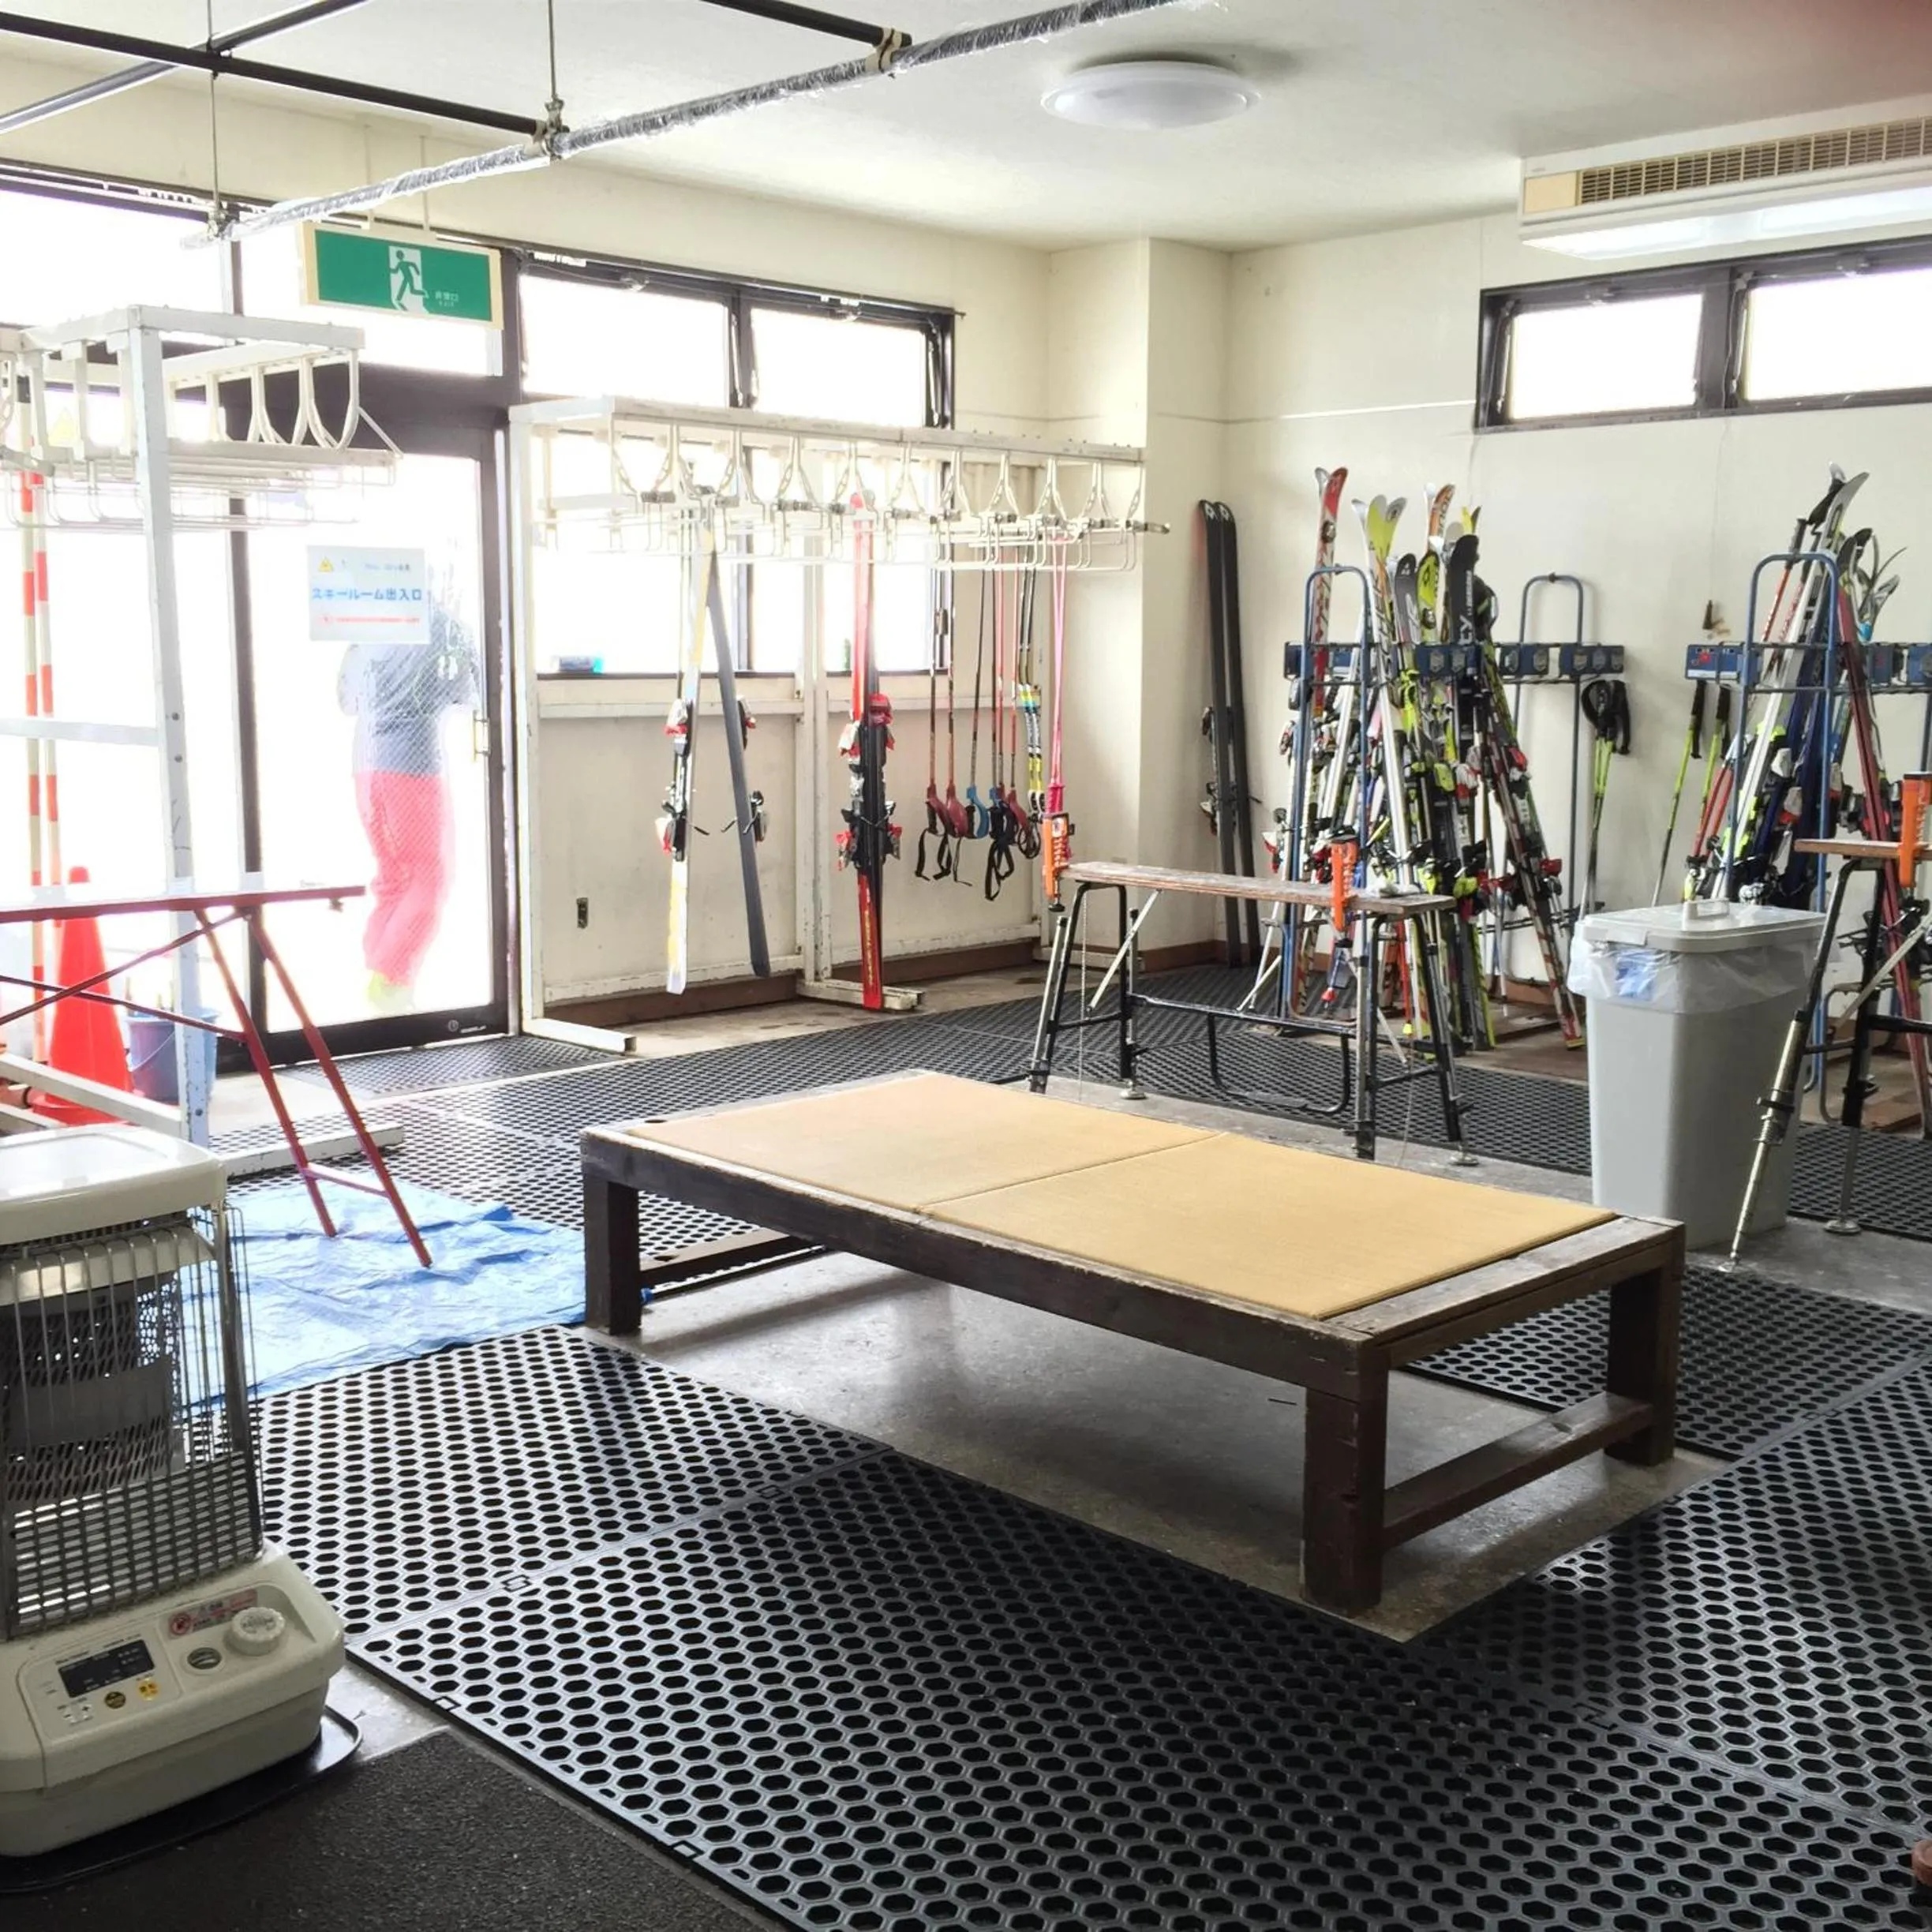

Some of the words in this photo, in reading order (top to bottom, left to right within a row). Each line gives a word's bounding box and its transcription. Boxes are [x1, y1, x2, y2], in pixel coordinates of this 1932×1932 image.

[313, 589, 422, 601] スキールーム出入口
